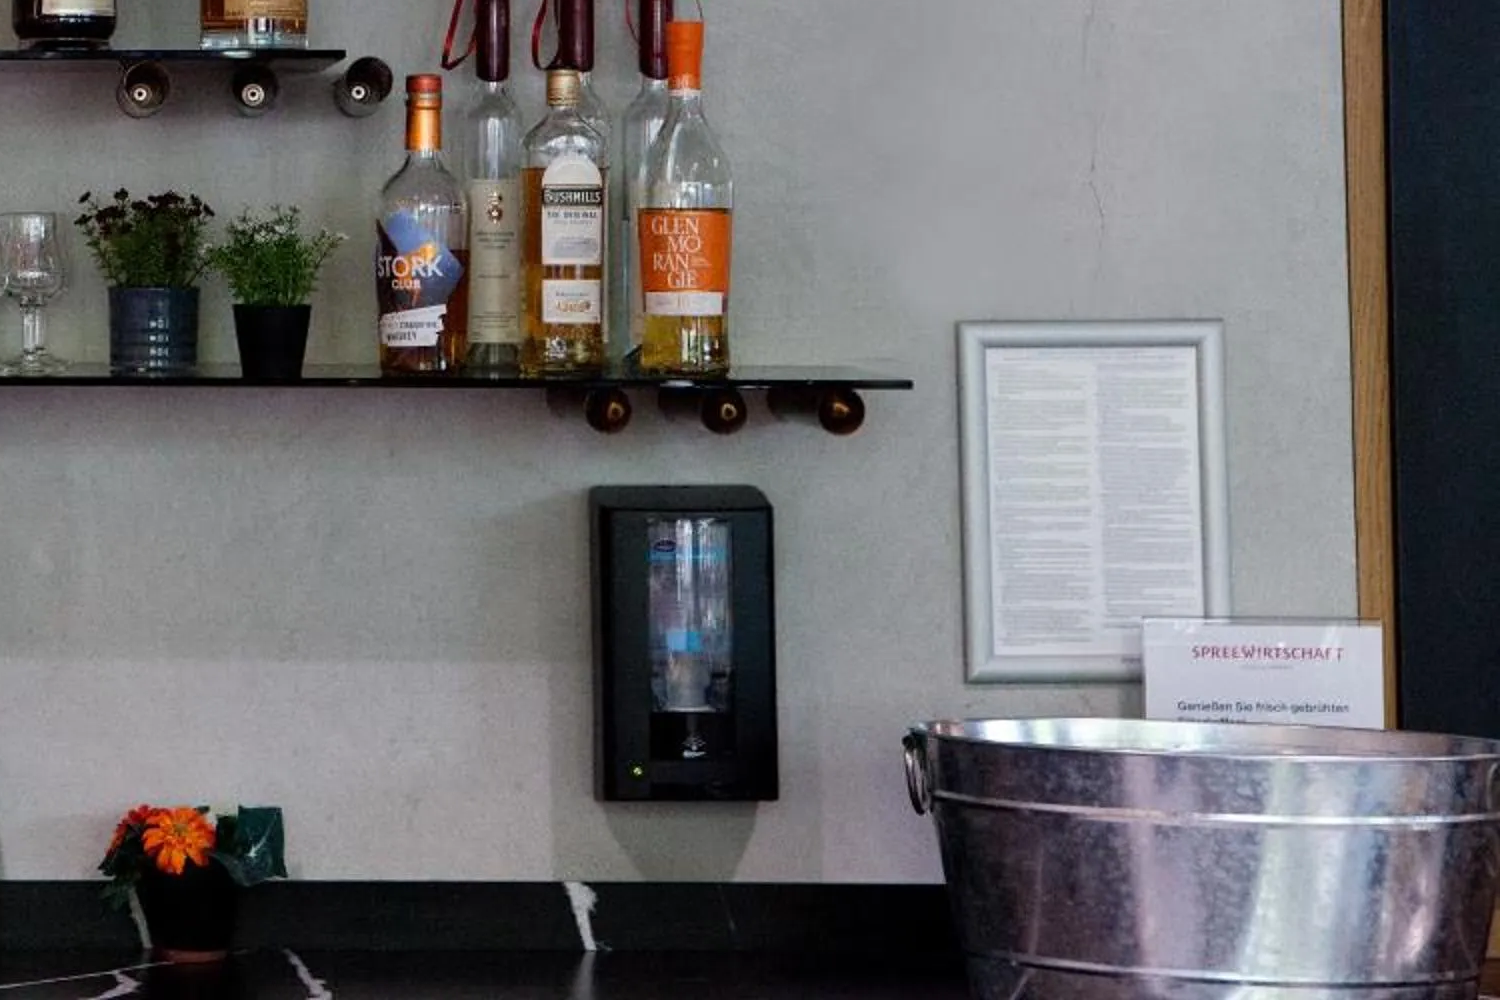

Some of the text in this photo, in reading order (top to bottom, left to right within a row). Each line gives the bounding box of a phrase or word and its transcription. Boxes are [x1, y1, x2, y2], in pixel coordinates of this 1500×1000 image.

[544, 190, 601, 204] BUSHMILLS
[652, 215, 700, 236] GLEN
[667, 235, 702, 253] MO
[377, 254, 445, 278] STORK
[653, 252, 690, 273] RAN
[667, 270, 699, 289] GIE
[1191, 645, 1345, 662] SPREEWIRTSCHAFT
